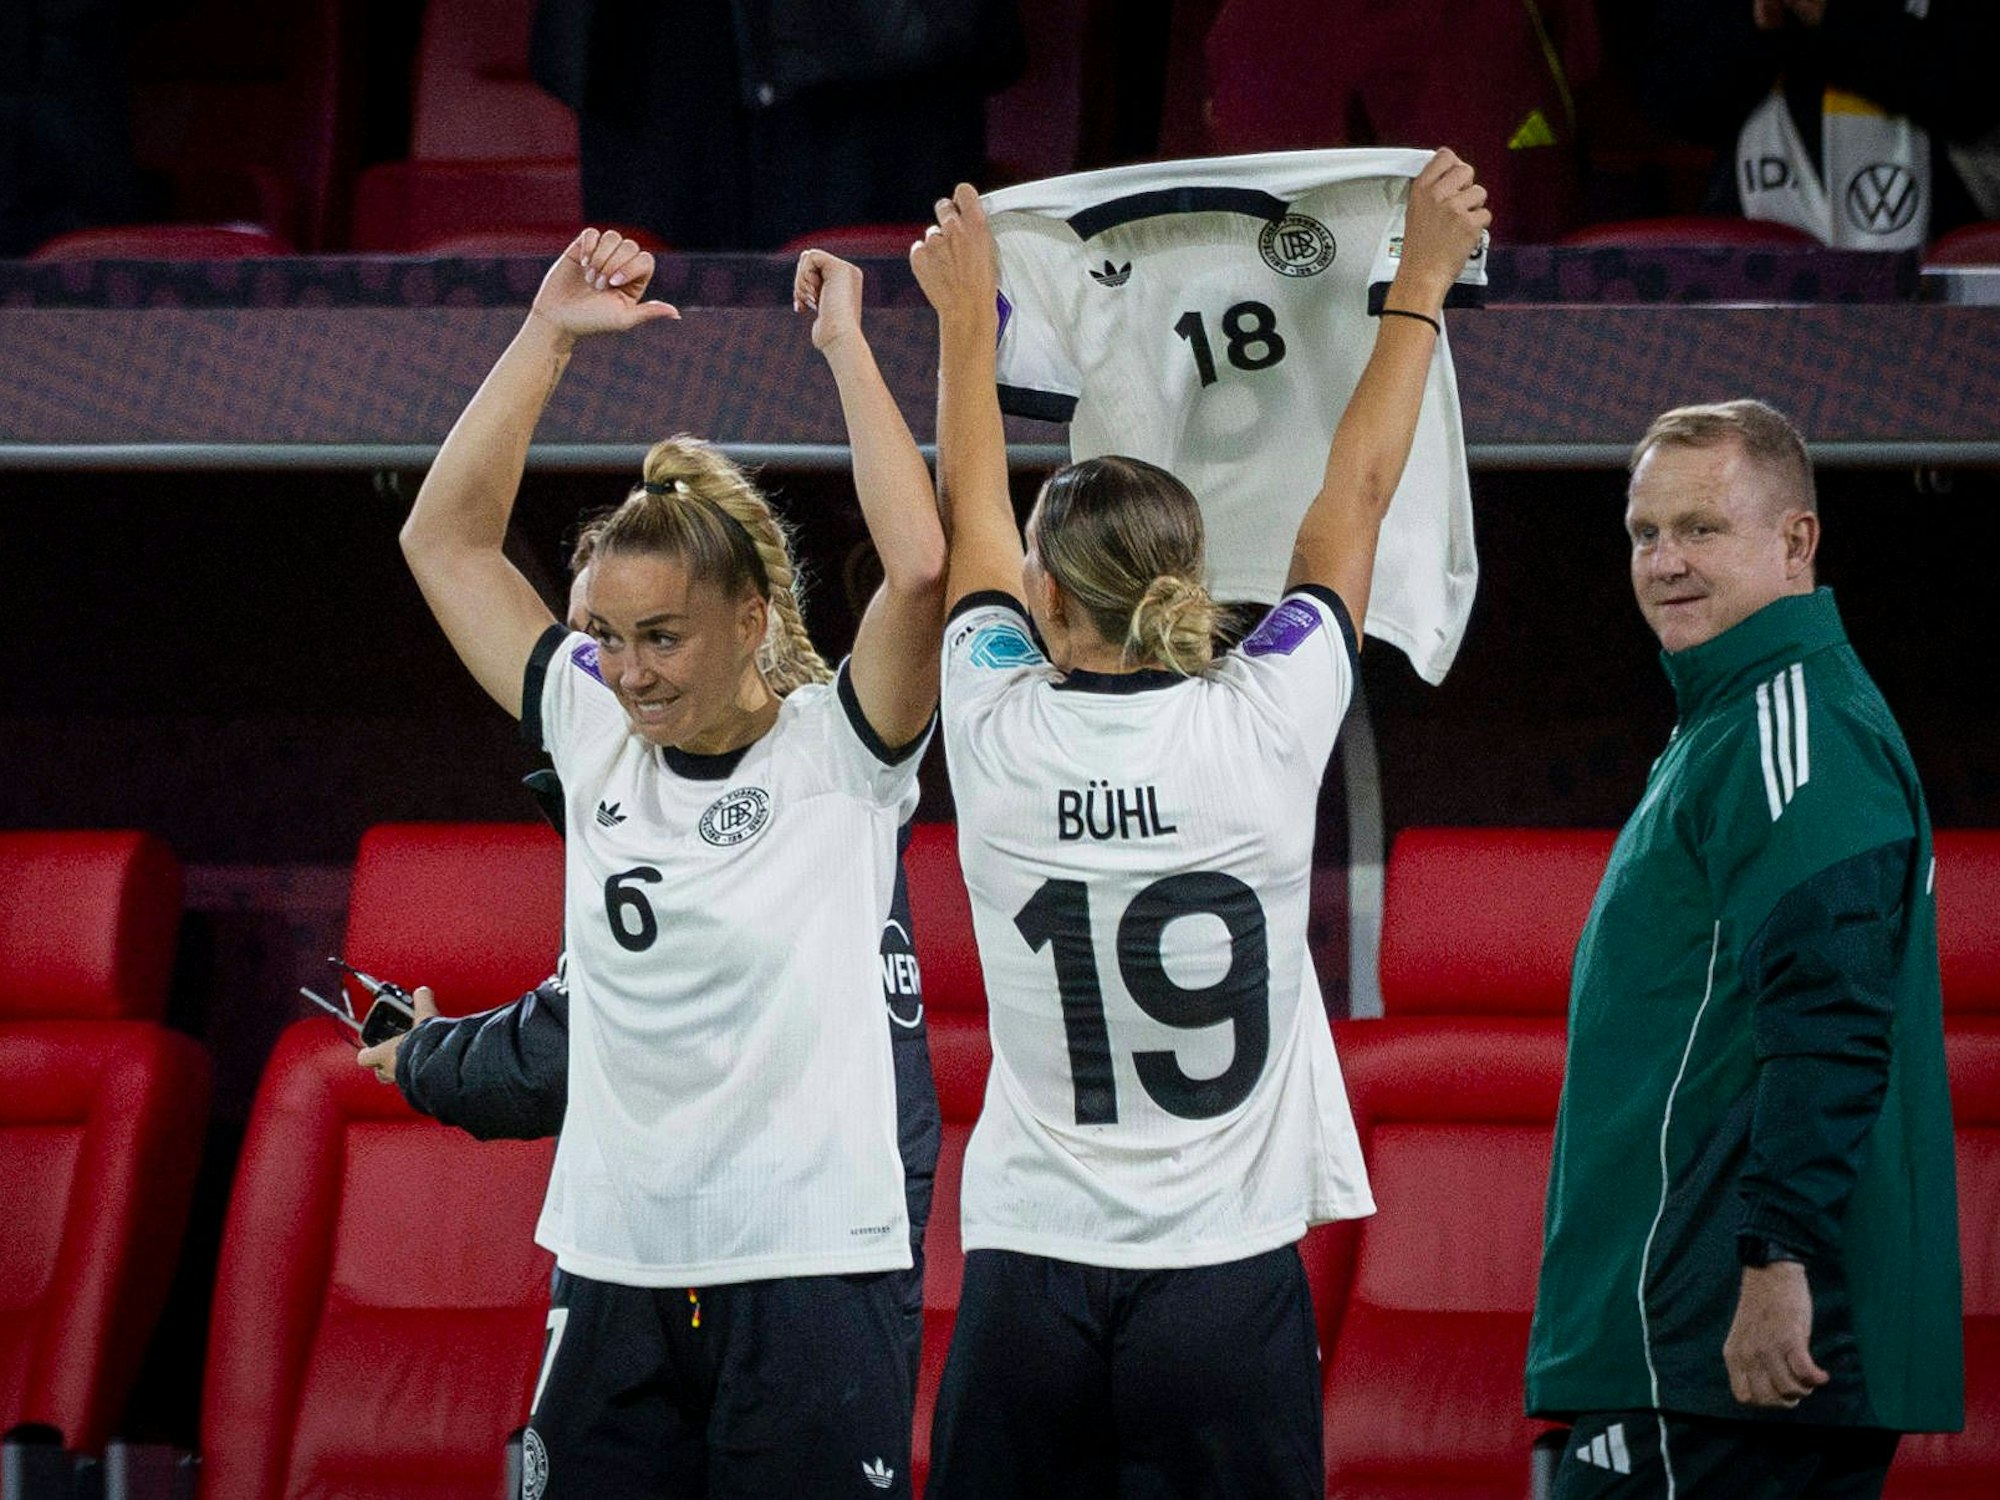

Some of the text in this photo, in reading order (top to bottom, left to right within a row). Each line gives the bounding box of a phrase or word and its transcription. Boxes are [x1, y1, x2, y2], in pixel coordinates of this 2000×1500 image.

[1173, 301, 1286, 388] 18
[1058, 780, 1177, 841] BÜHL
[604, 866, 663, 953] 6
[1013, 871, 1270, 1125] 19
